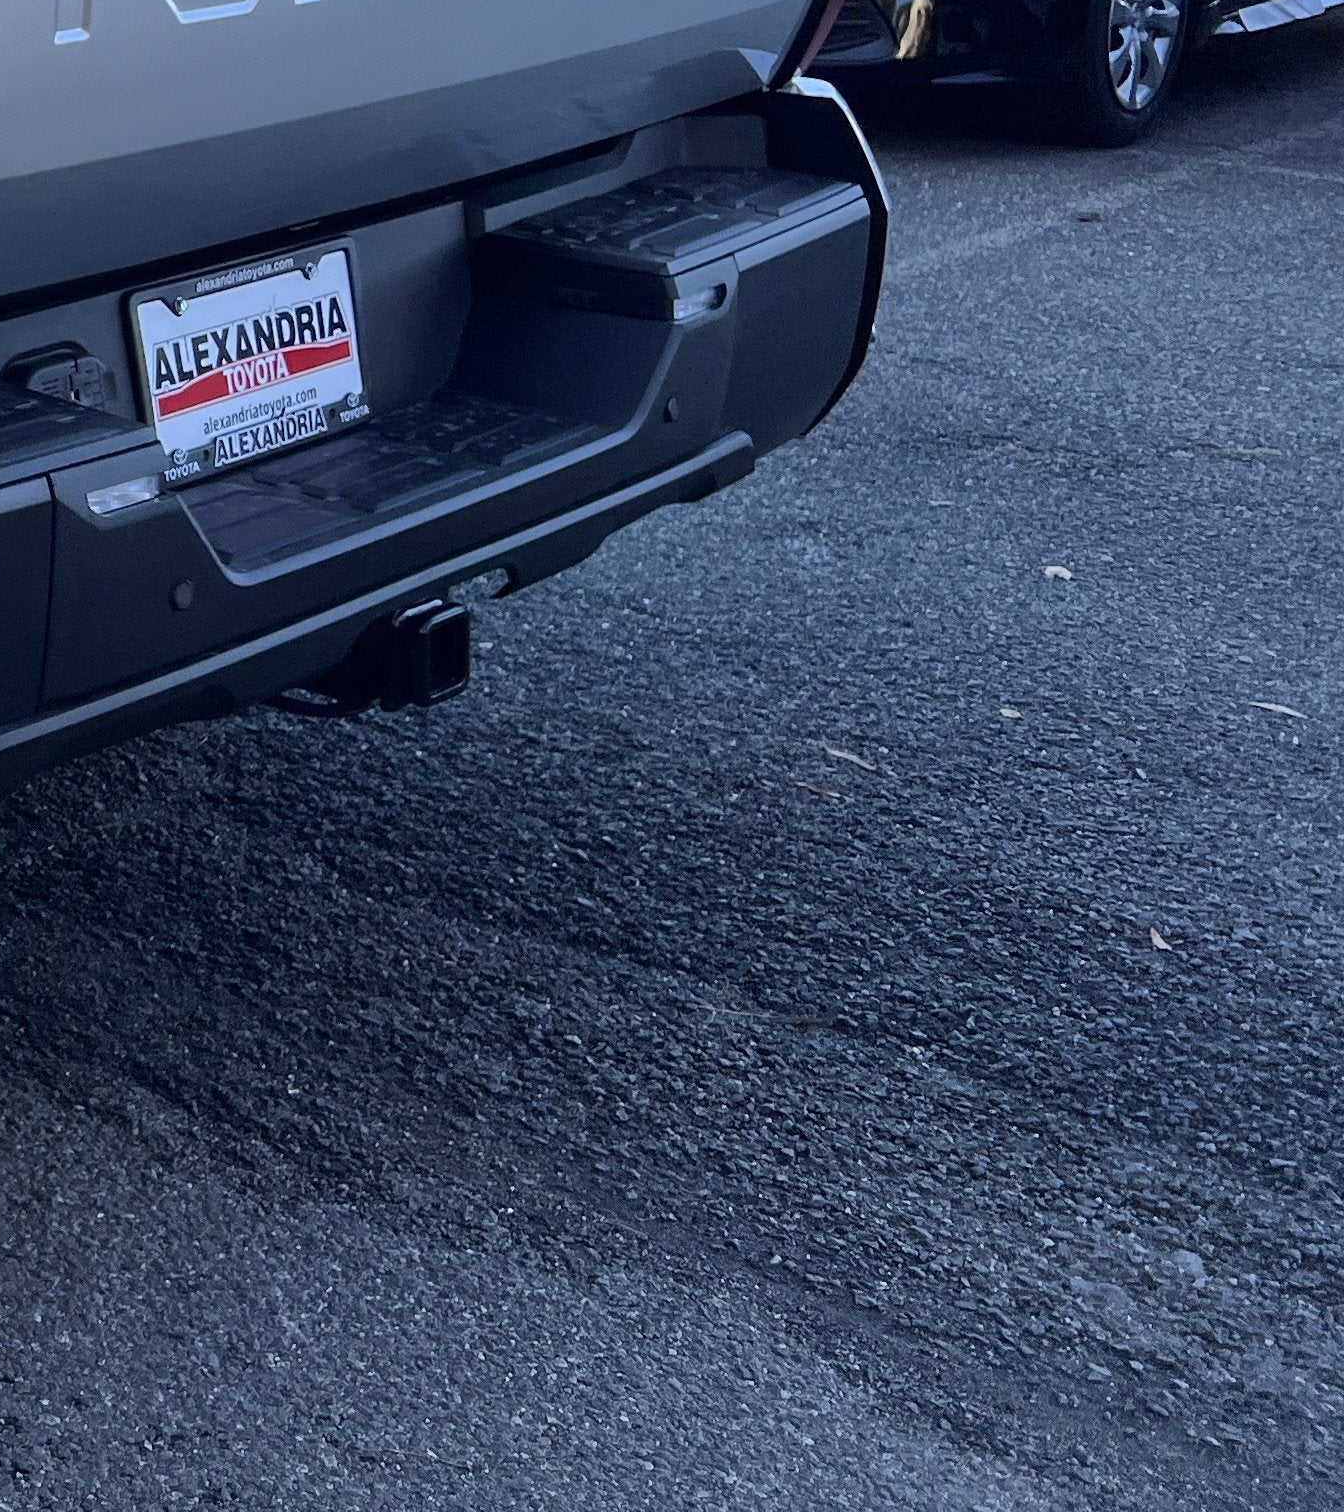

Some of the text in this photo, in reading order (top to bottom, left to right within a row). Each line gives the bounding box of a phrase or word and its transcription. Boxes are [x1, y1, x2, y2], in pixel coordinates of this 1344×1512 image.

[194, 257, 295, 293] alexandriatoyota.com
[154, 295, 349, 392] ALEXANDRIA
[222, 352, 290, 395] TOYOTA
[202, 387, 318, 436] alexandriatoyota.com
[339, 404, 371, 424] TOYOTA
[214, 406, 328, 468] ALEXANDRIA
[163, 461, 201, 483] TOYOTA
